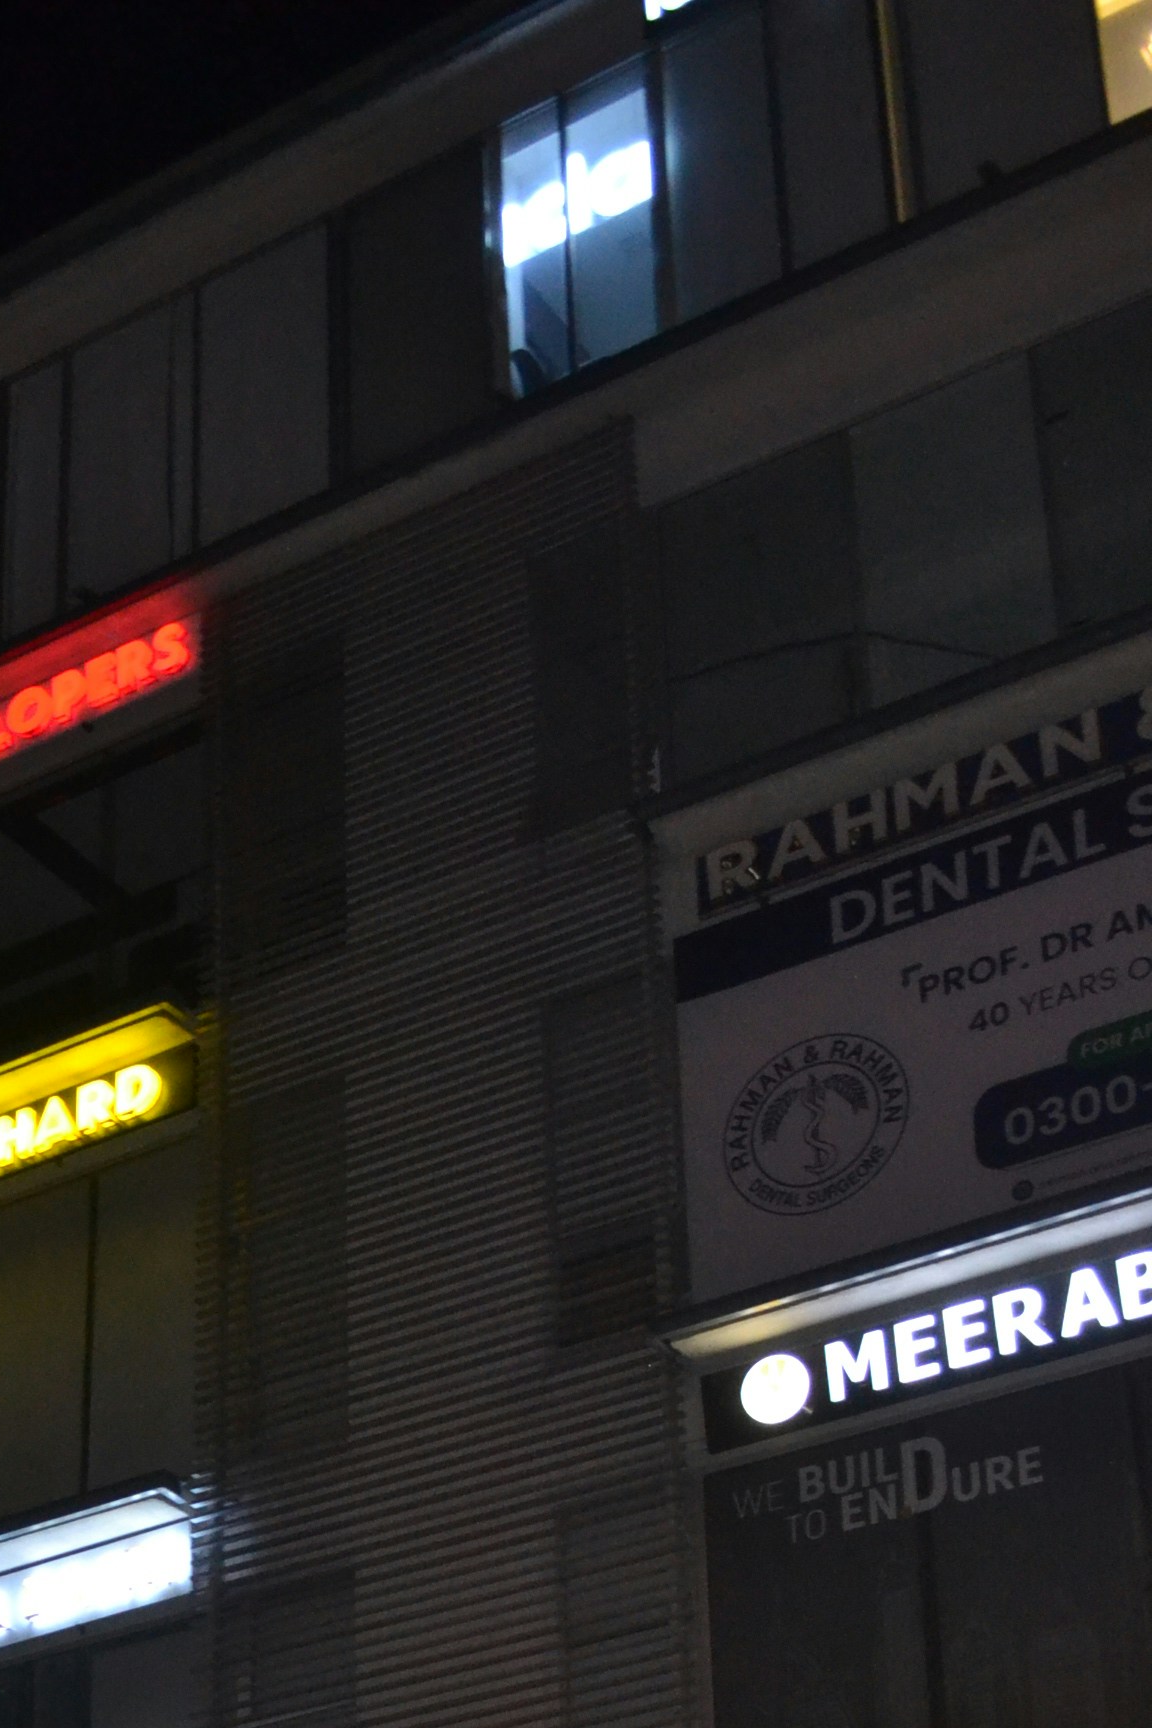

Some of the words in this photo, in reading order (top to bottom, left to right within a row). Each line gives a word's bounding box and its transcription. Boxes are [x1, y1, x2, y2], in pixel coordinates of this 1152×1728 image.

[703, 706, 1101, 902] RAHMAN
[828, 808, 1107, 945] DENTAL
[917, 945, 1030, 1003] PROF.
[1040, 922, 1094, 963] DR
[968, 1001, 1010, 1032] 40
[1017, 966, 1118, 1016] YEARS
[728, 1057, 794, 1172] RAHMAN
[830, 1040, 903, 1124] RAHMAN
[748, 1178, 802, 1208] DENTAL
[806, 1145, 885, 1206] SURGEONS
[732, 1480, 784, 1519] WE
[784, 1509, 828, 1544] TO
